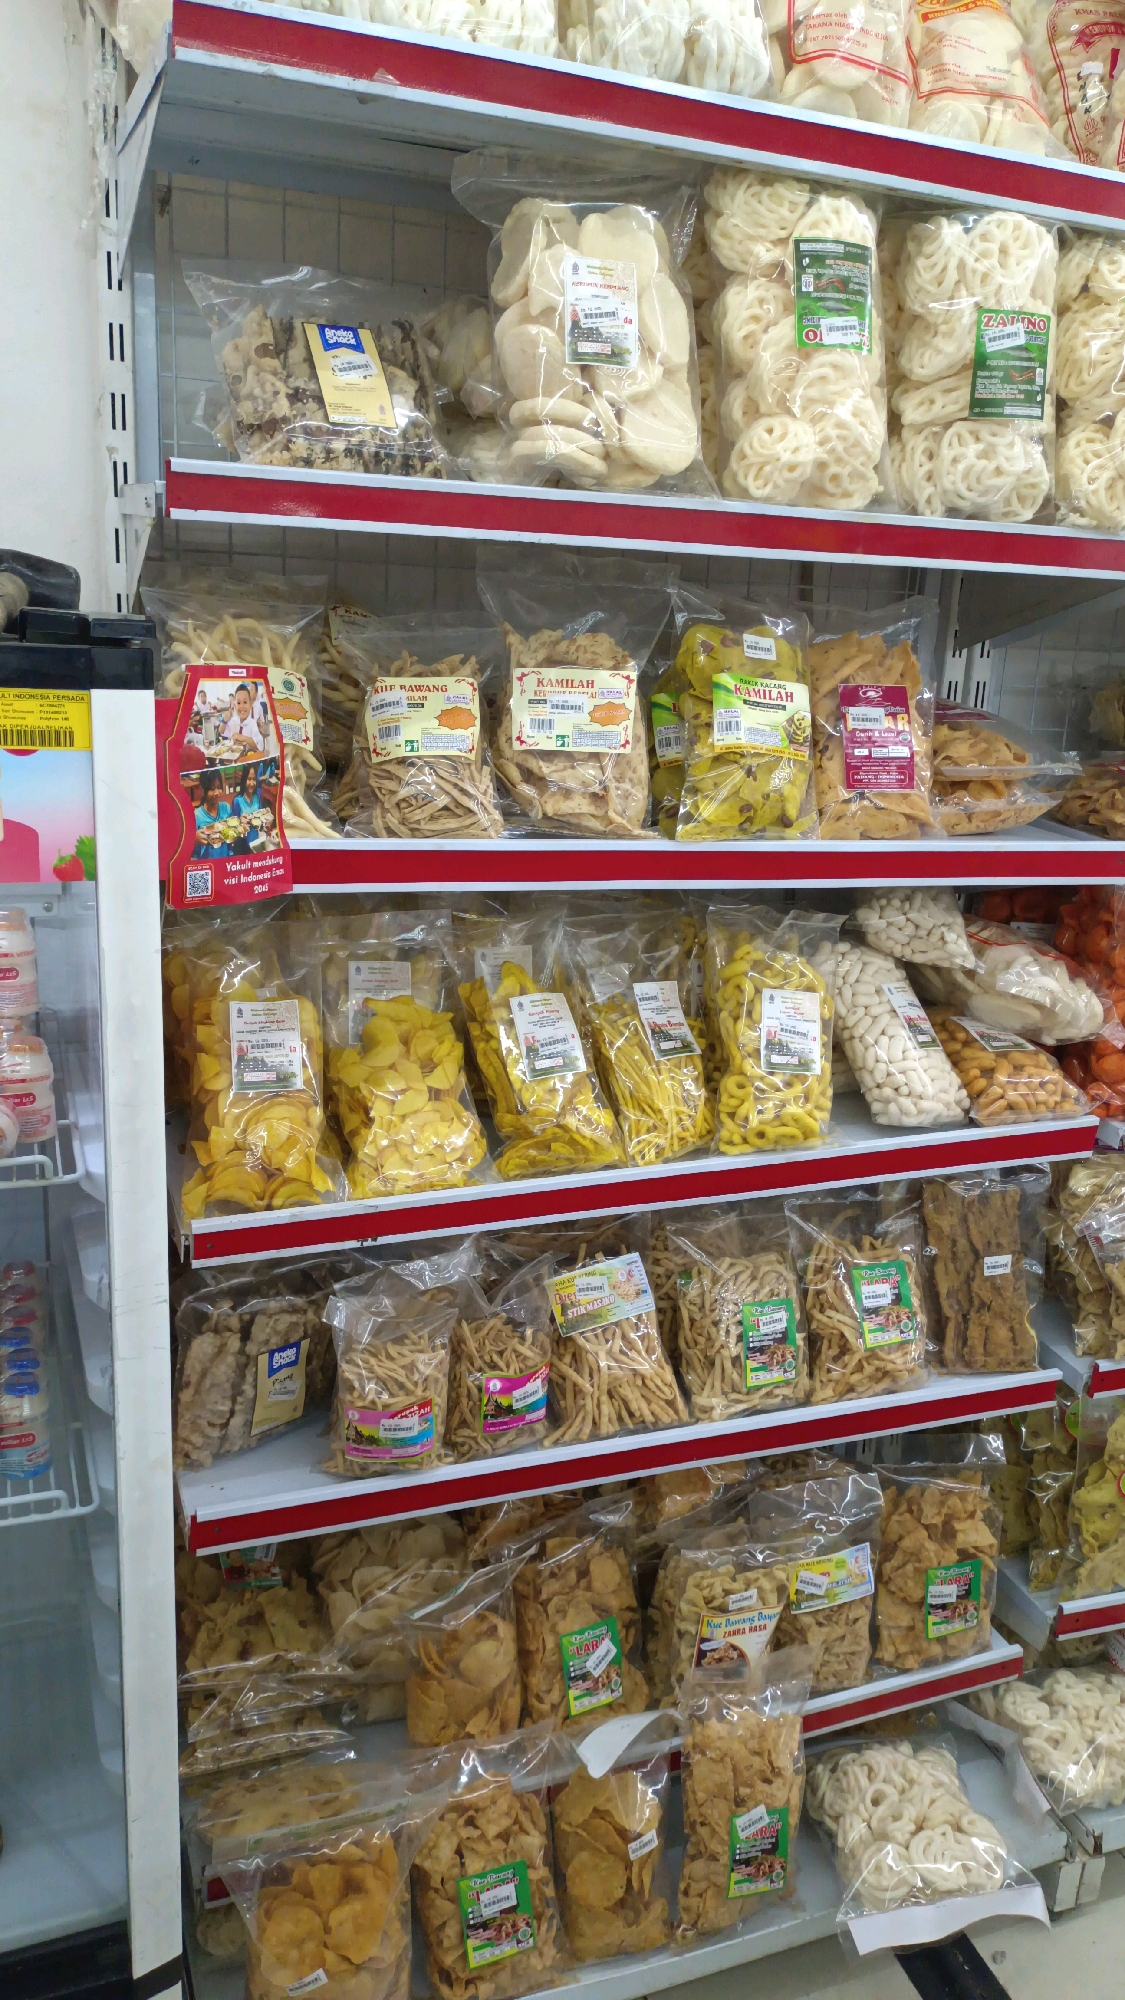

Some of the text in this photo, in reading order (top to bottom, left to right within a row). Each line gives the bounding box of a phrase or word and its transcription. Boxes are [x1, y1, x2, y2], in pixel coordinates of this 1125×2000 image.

[325, 327, 354, 338] Aneka
[326, 335, 357, 346] Snack
[399, 684, 448, 693] BAWANG
[536, 677, 595, 689] KAMILAH
[12, 693, 51, 701] INDONESIA
[734, 684, 794, 703] KAMILAH
[225, 861, 252, 872] Yakult
[223, 878, 239, 886] visi
[240, 869, 272, 884] Indonesia
[567, 1293, 616, 1319] STIK MASAKO
[272, 1347, 297, 1360] Aneka
[272, 1353, 297, 1369] Snack
[706, 1618, 723, 1630] Kue
[724, 1615, 757, 1629] Bawang
